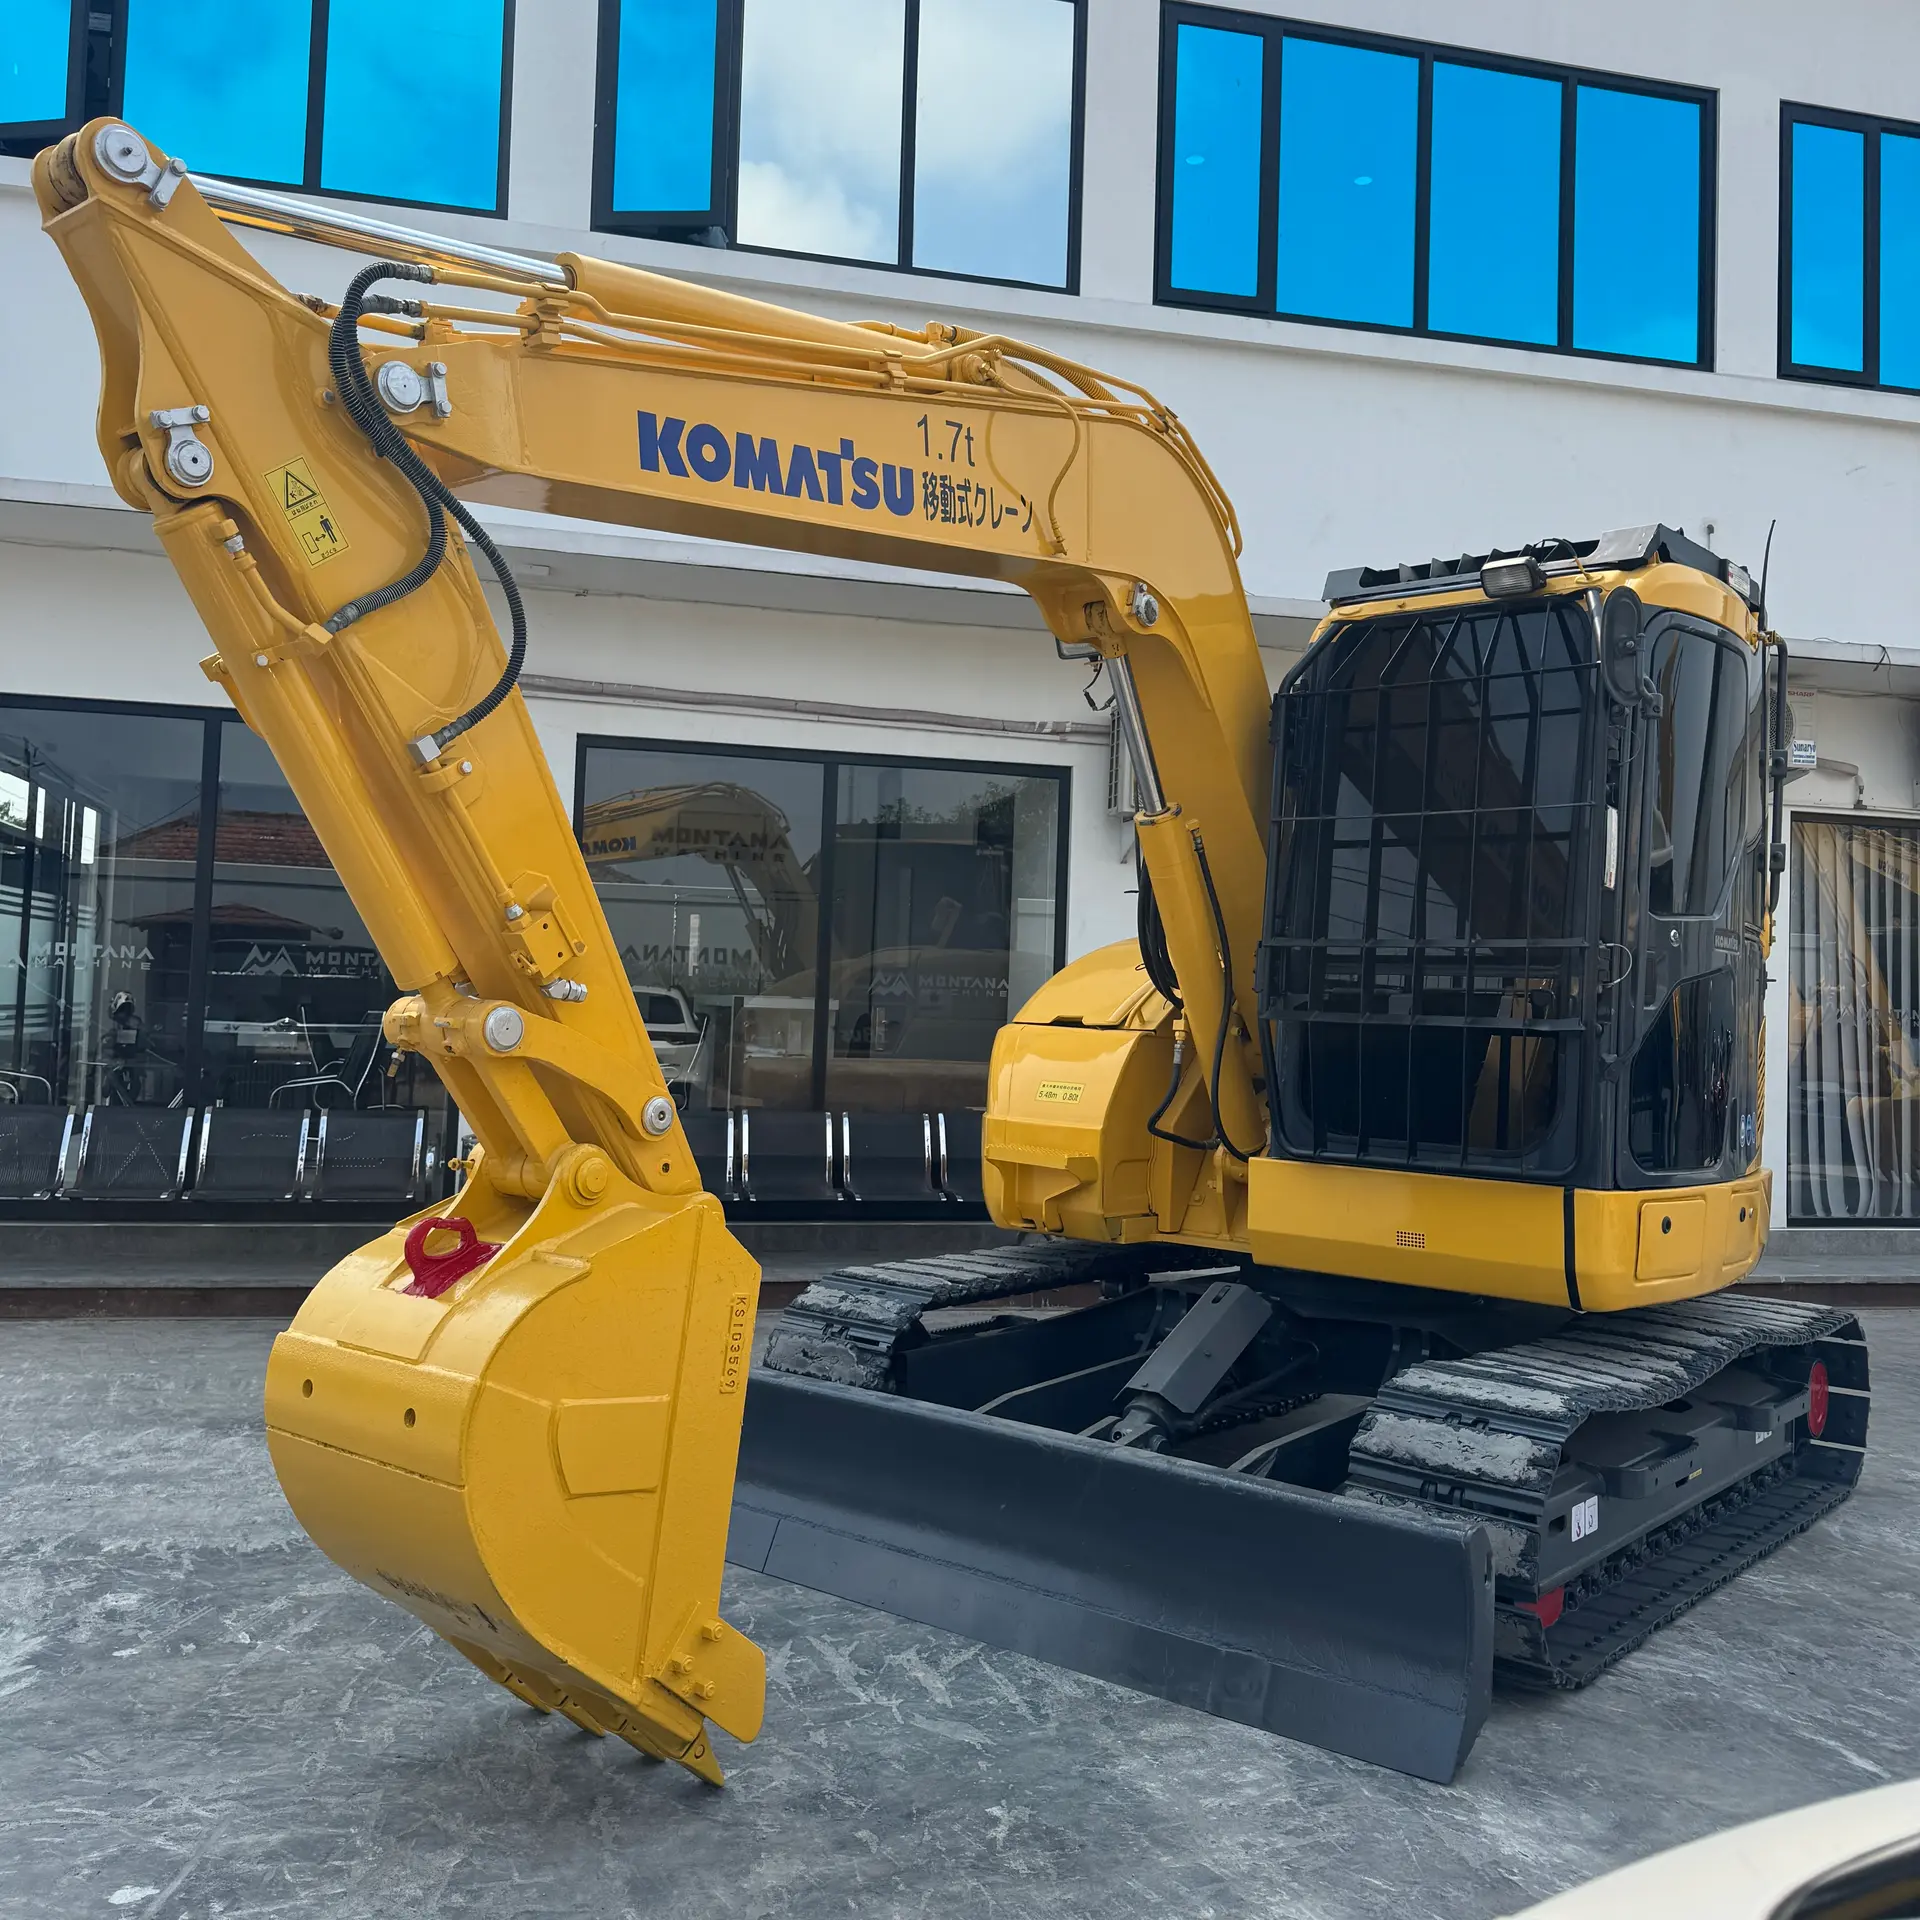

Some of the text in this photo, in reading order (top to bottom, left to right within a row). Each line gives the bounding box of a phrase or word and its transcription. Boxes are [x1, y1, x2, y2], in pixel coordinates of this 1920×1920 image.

[637, 410, 915, 516] KOMATSU
[917, 413, 976, 467] 1.7t
[922, 470, 1033, 533] 移動式クレーン
[918, 974, 1010, 990] MONTANA
